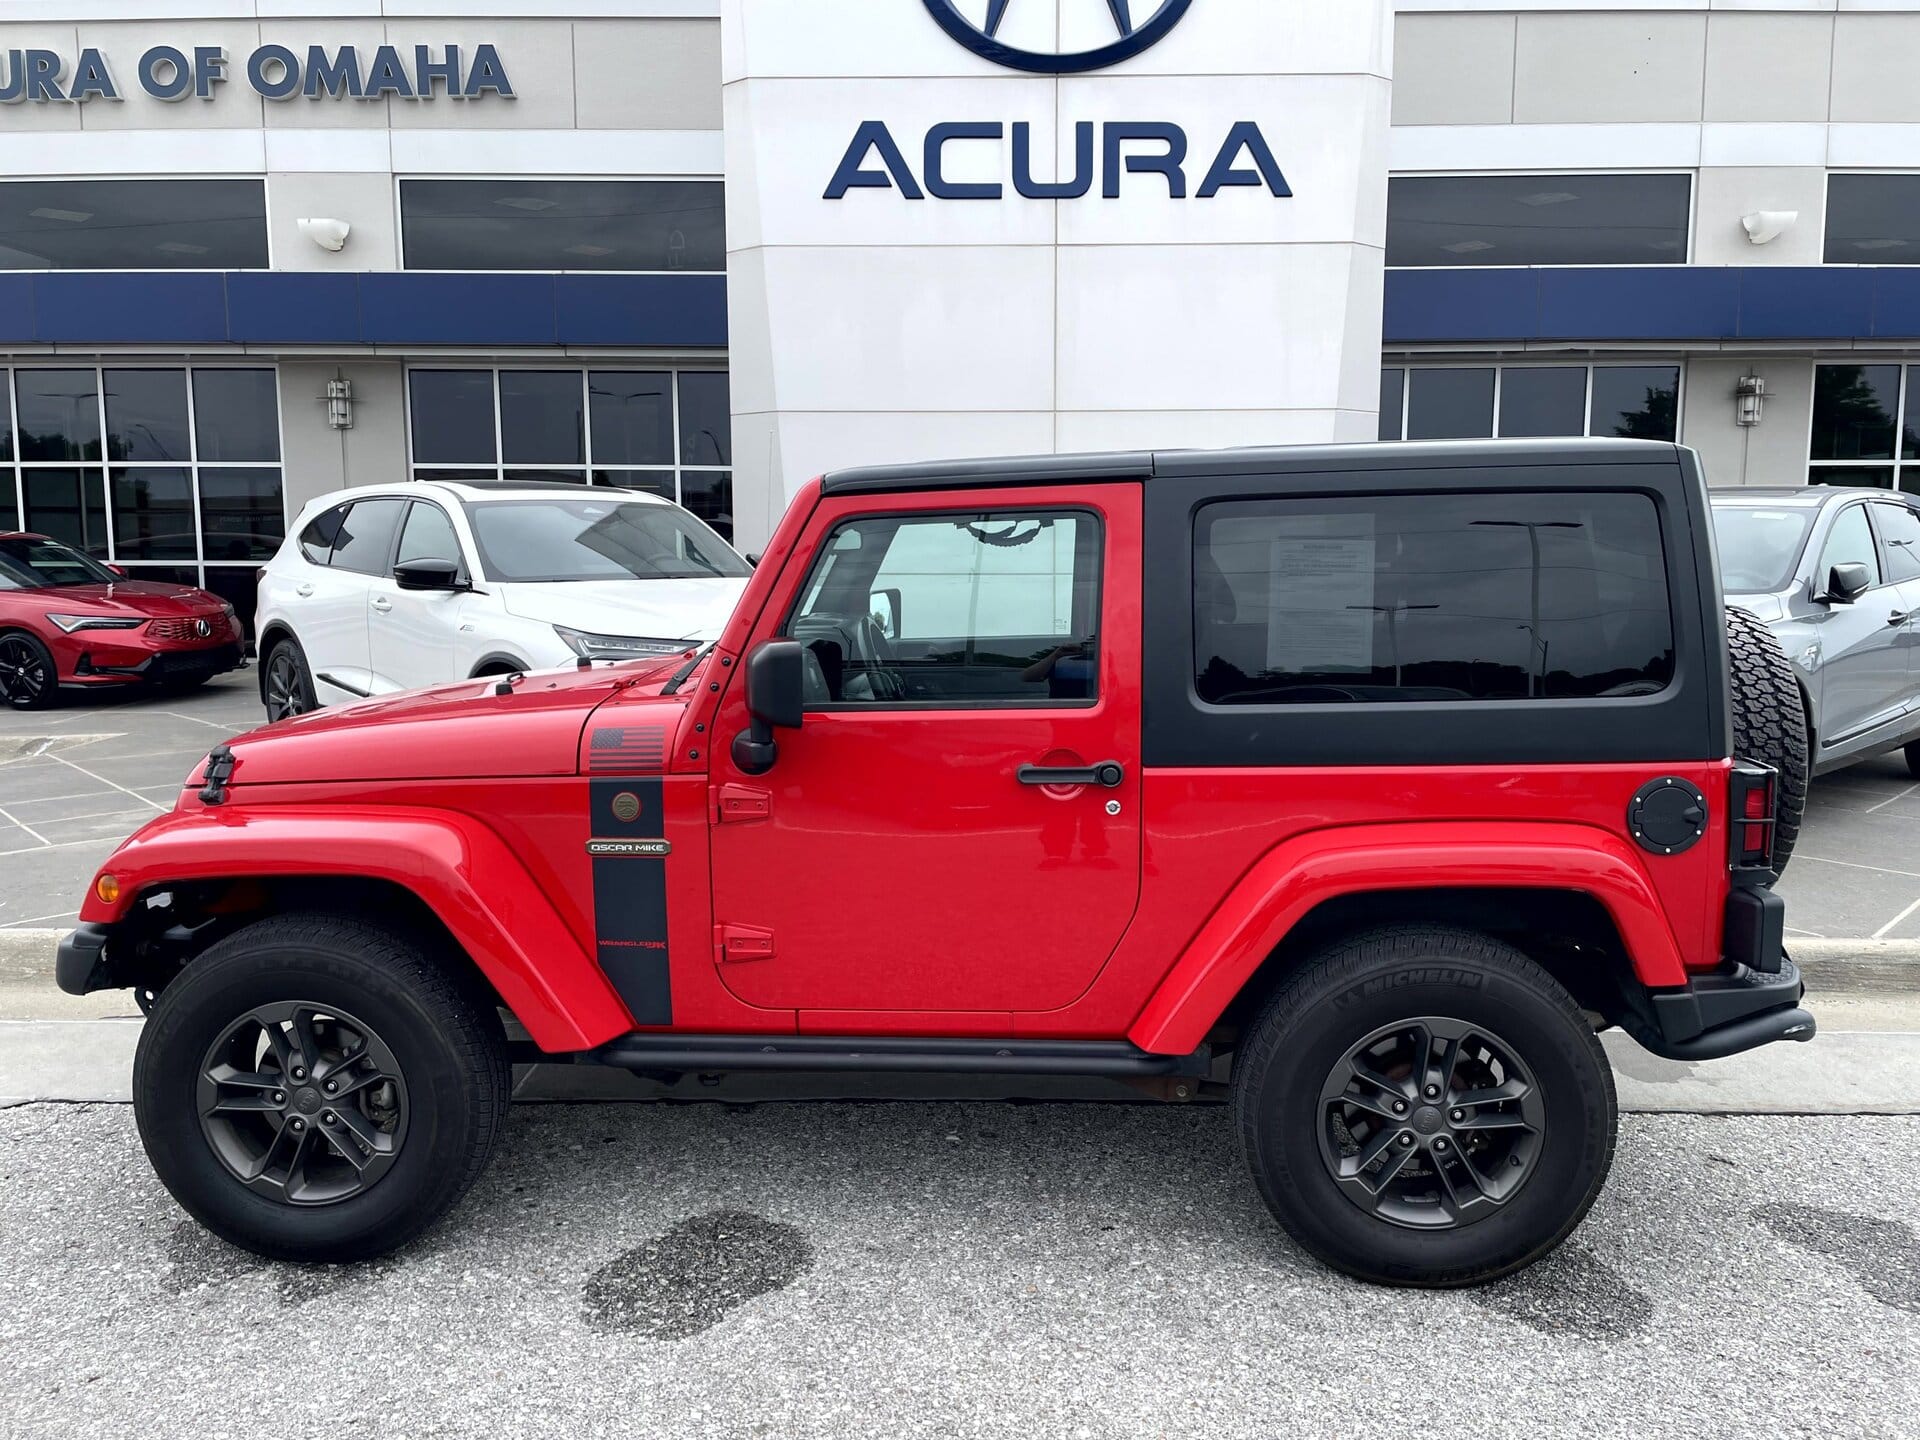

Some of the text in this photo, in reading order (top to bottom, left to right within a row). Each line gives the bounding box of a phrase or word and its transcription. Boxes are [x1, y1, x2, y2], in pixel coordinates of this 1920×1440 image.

[137, 44, 226, 100] OF
[246, 43, 517, 100] OMAHA
[822, 120, 1293, 199] ACURA
[591, 844, 665, 852] OSCAR MIKE
[1363, 967, 1483, 996] MICHELIN
